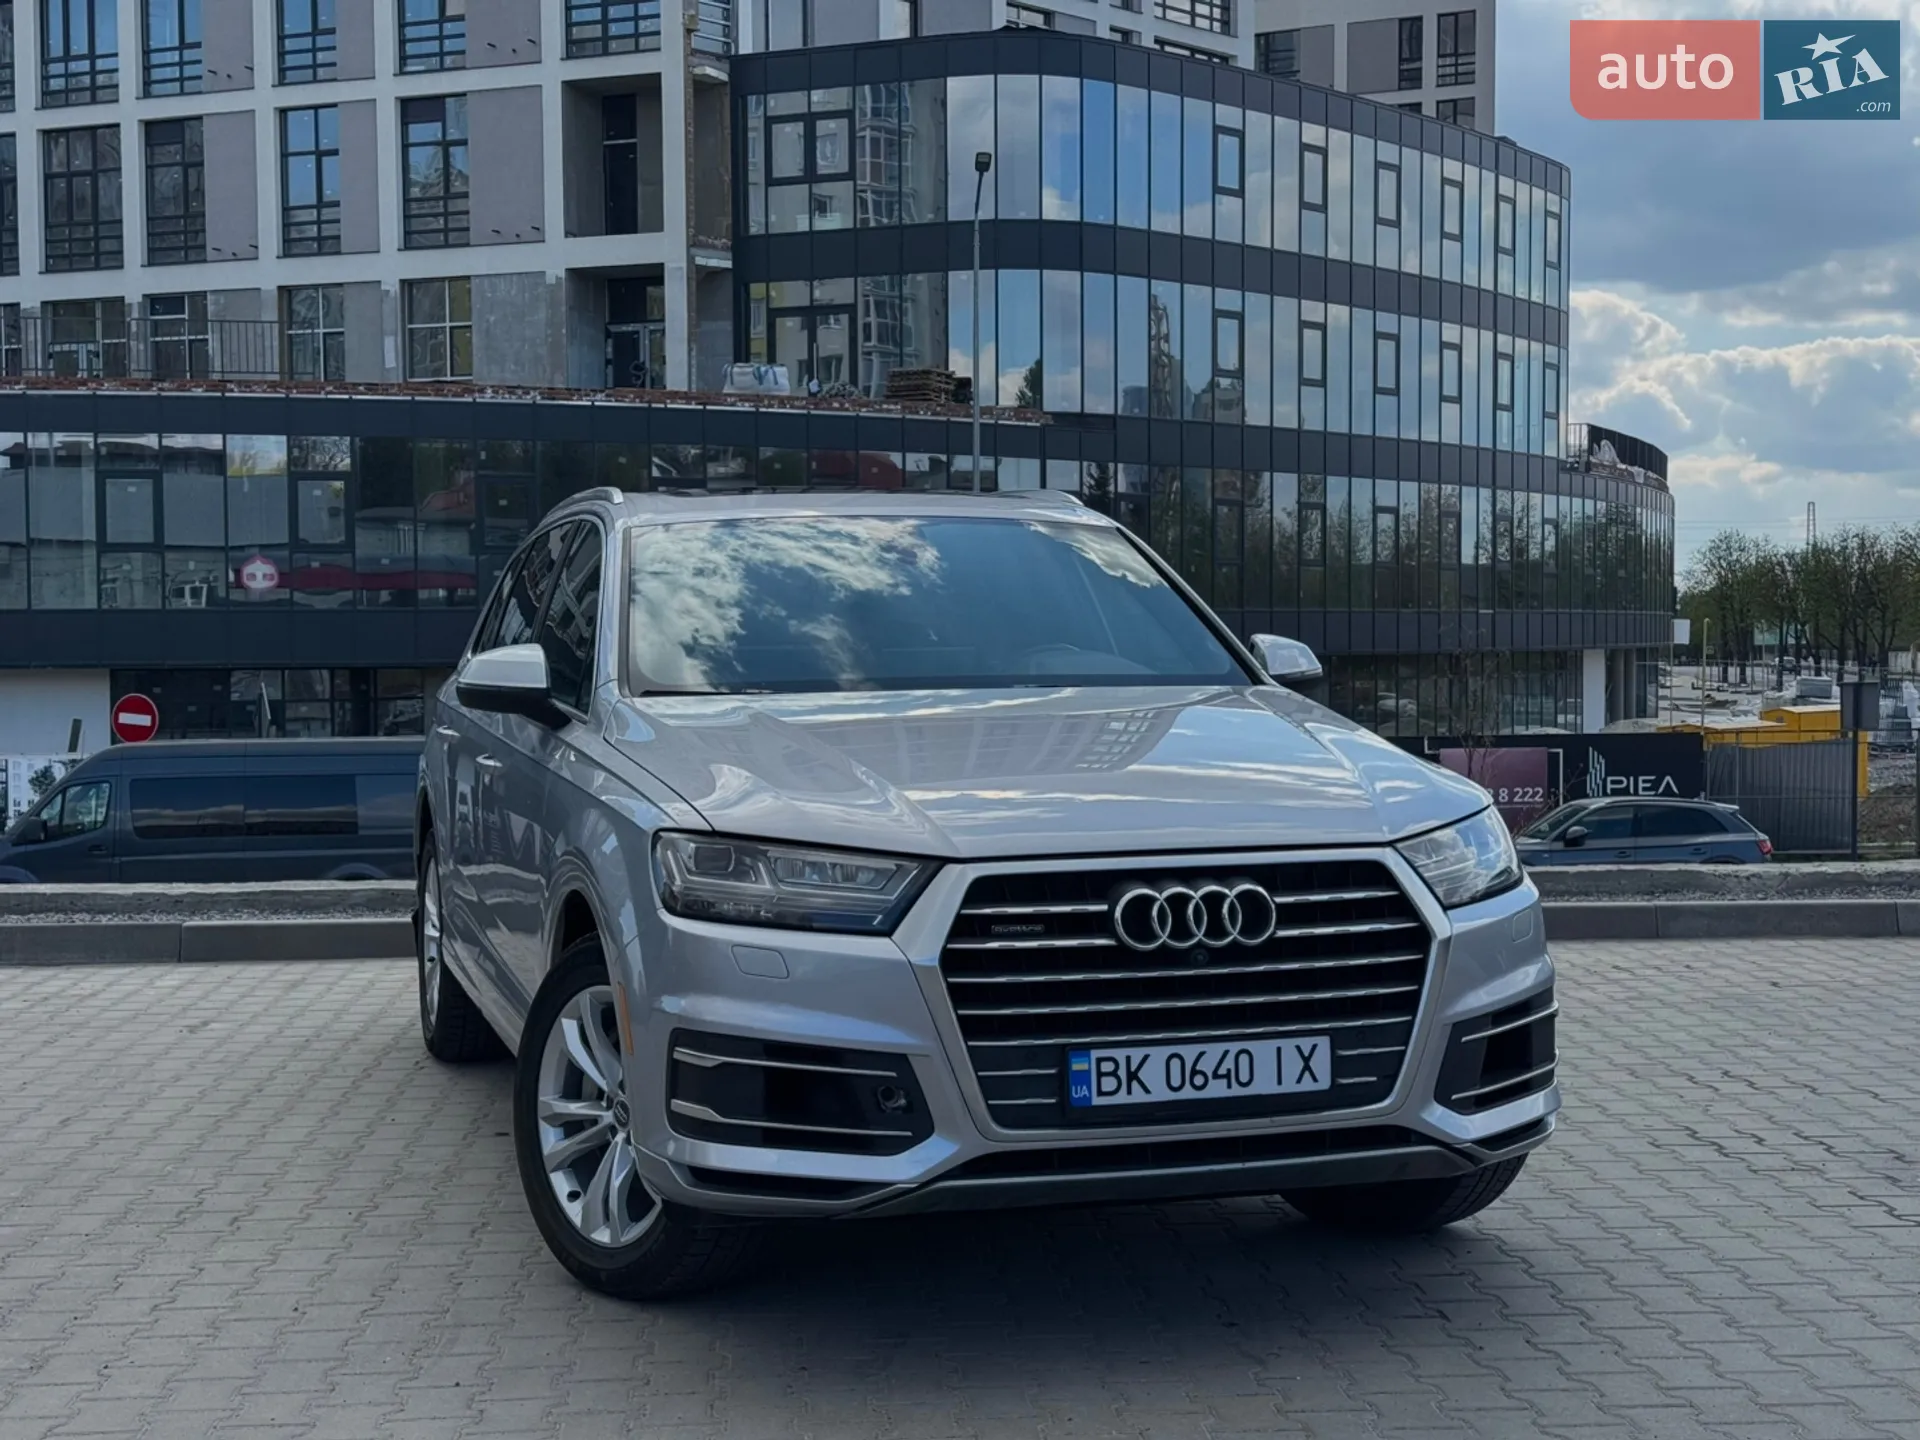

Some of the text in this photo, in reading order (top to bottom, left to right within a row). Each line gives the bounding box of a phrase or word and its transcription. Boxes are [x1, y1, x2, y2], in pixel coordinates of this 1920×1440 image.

[1498, 787, 1509, 803] 8
[1513, 786, 1544, 803] 222
[1095, 1043, 1319, 1097] BK 0640 IX
[1071, 1085, 1090, 1098] UA
